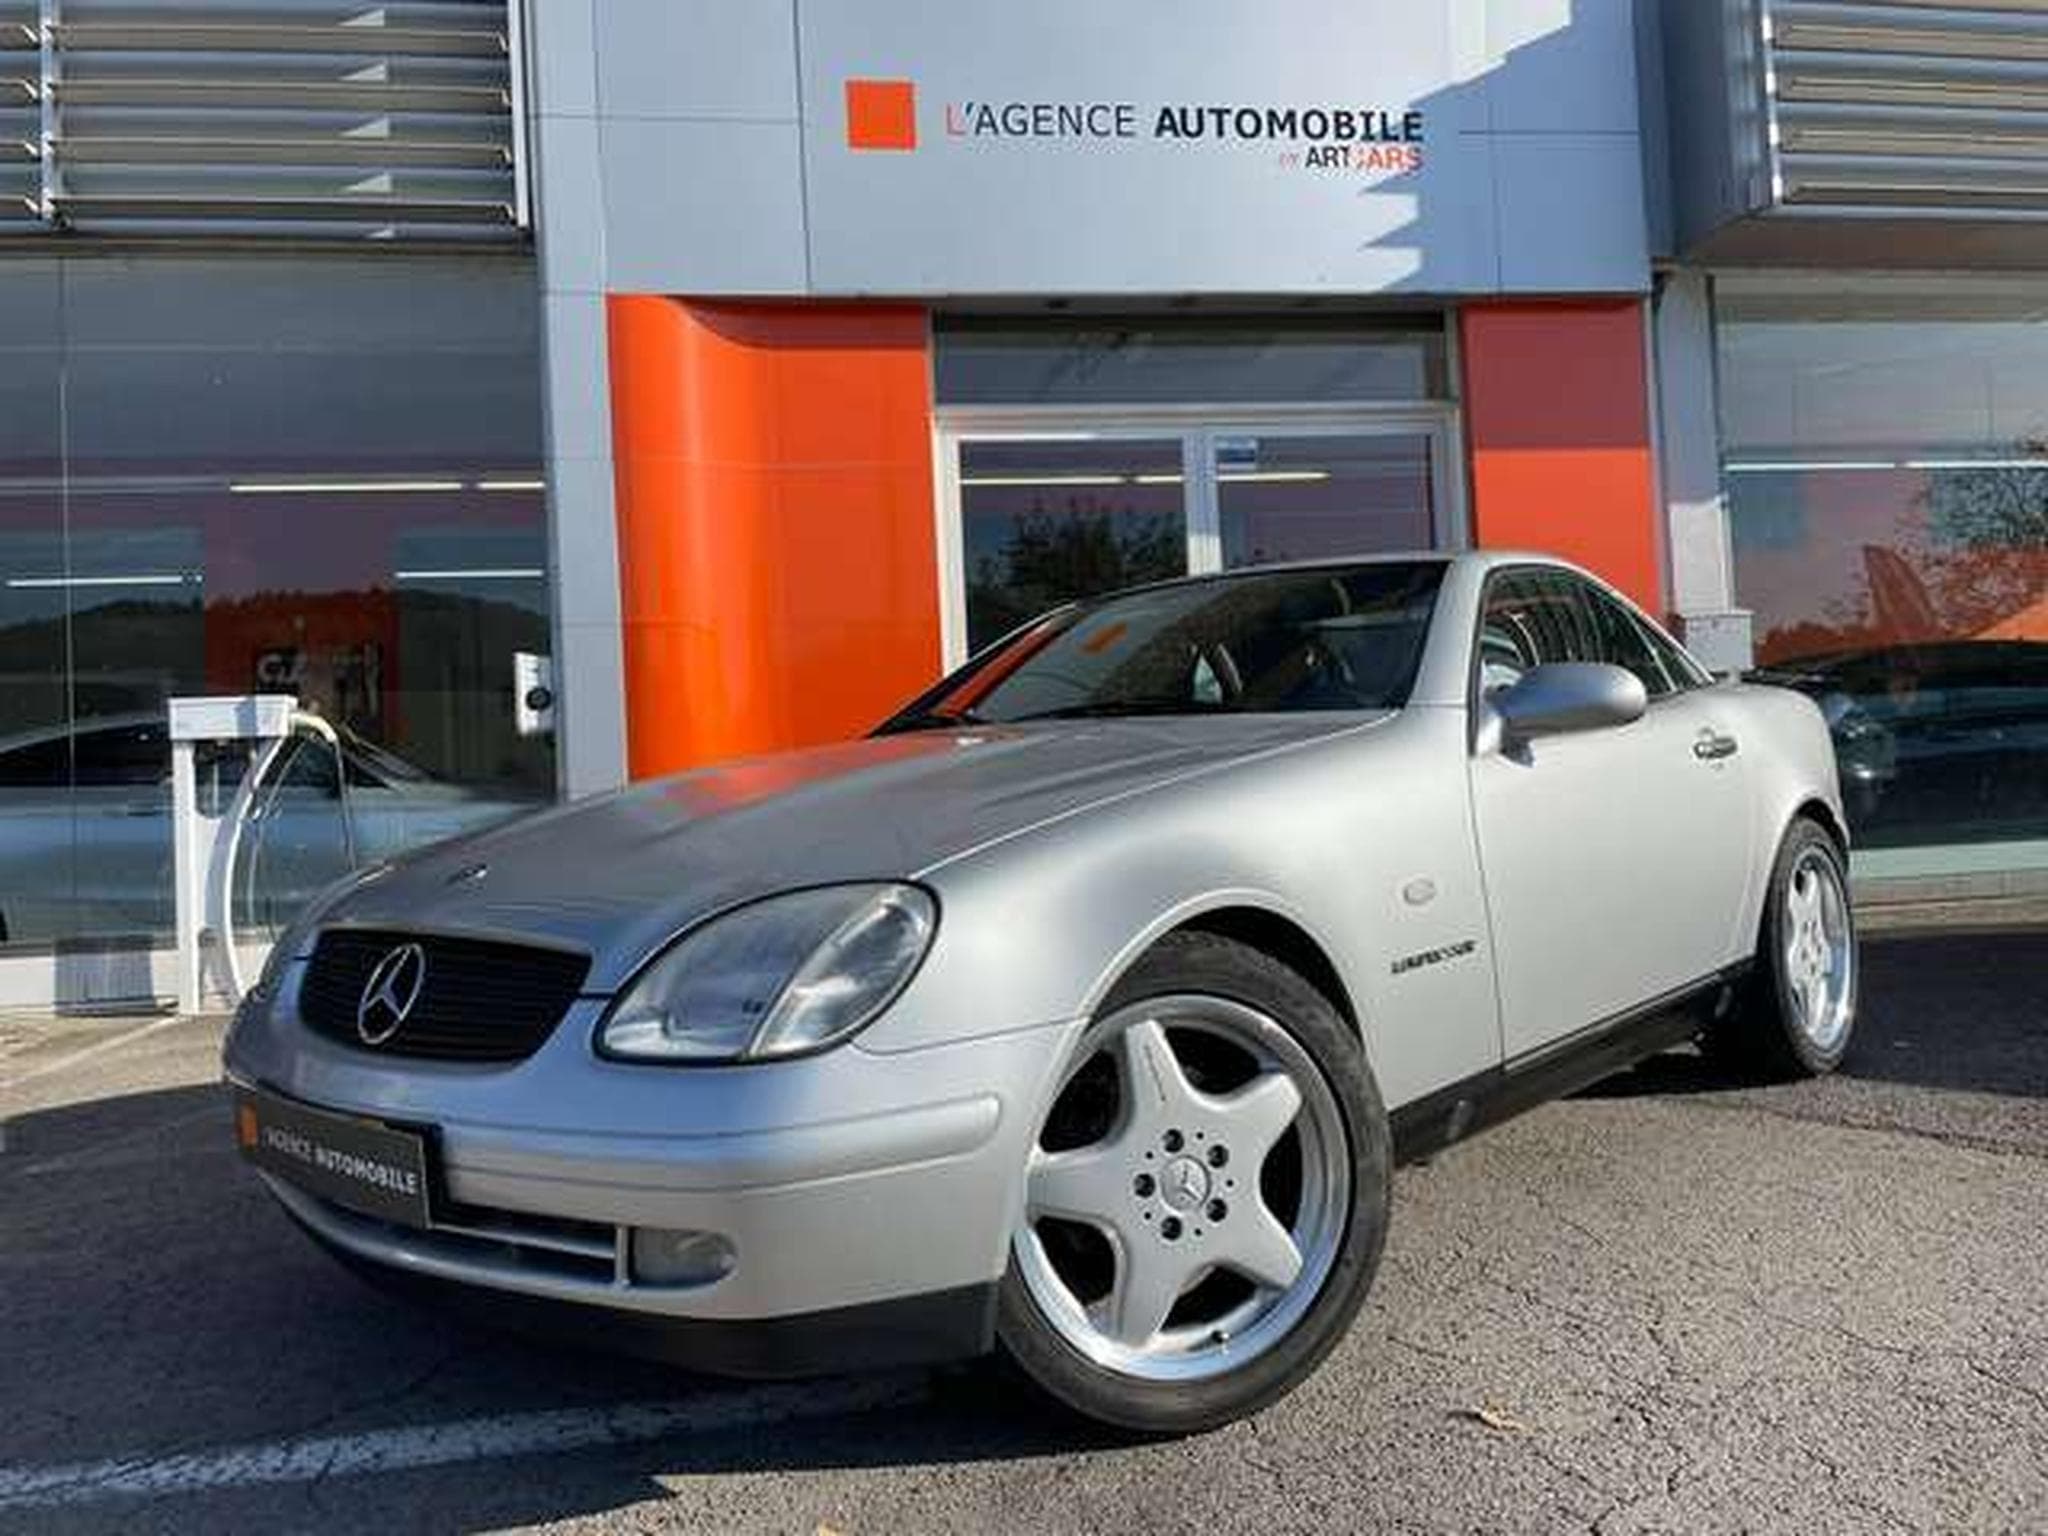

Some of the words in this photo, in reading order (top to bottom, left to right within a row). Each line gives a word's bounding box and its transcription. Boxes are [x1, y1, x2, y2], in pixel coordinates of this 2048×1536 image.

[945, 102, 1136, 137] L'AGENCE
[1154, 106, 1424, 142] AUTOMOBILE
[315, 1143, 418, 1196] AUTOMOBILE
